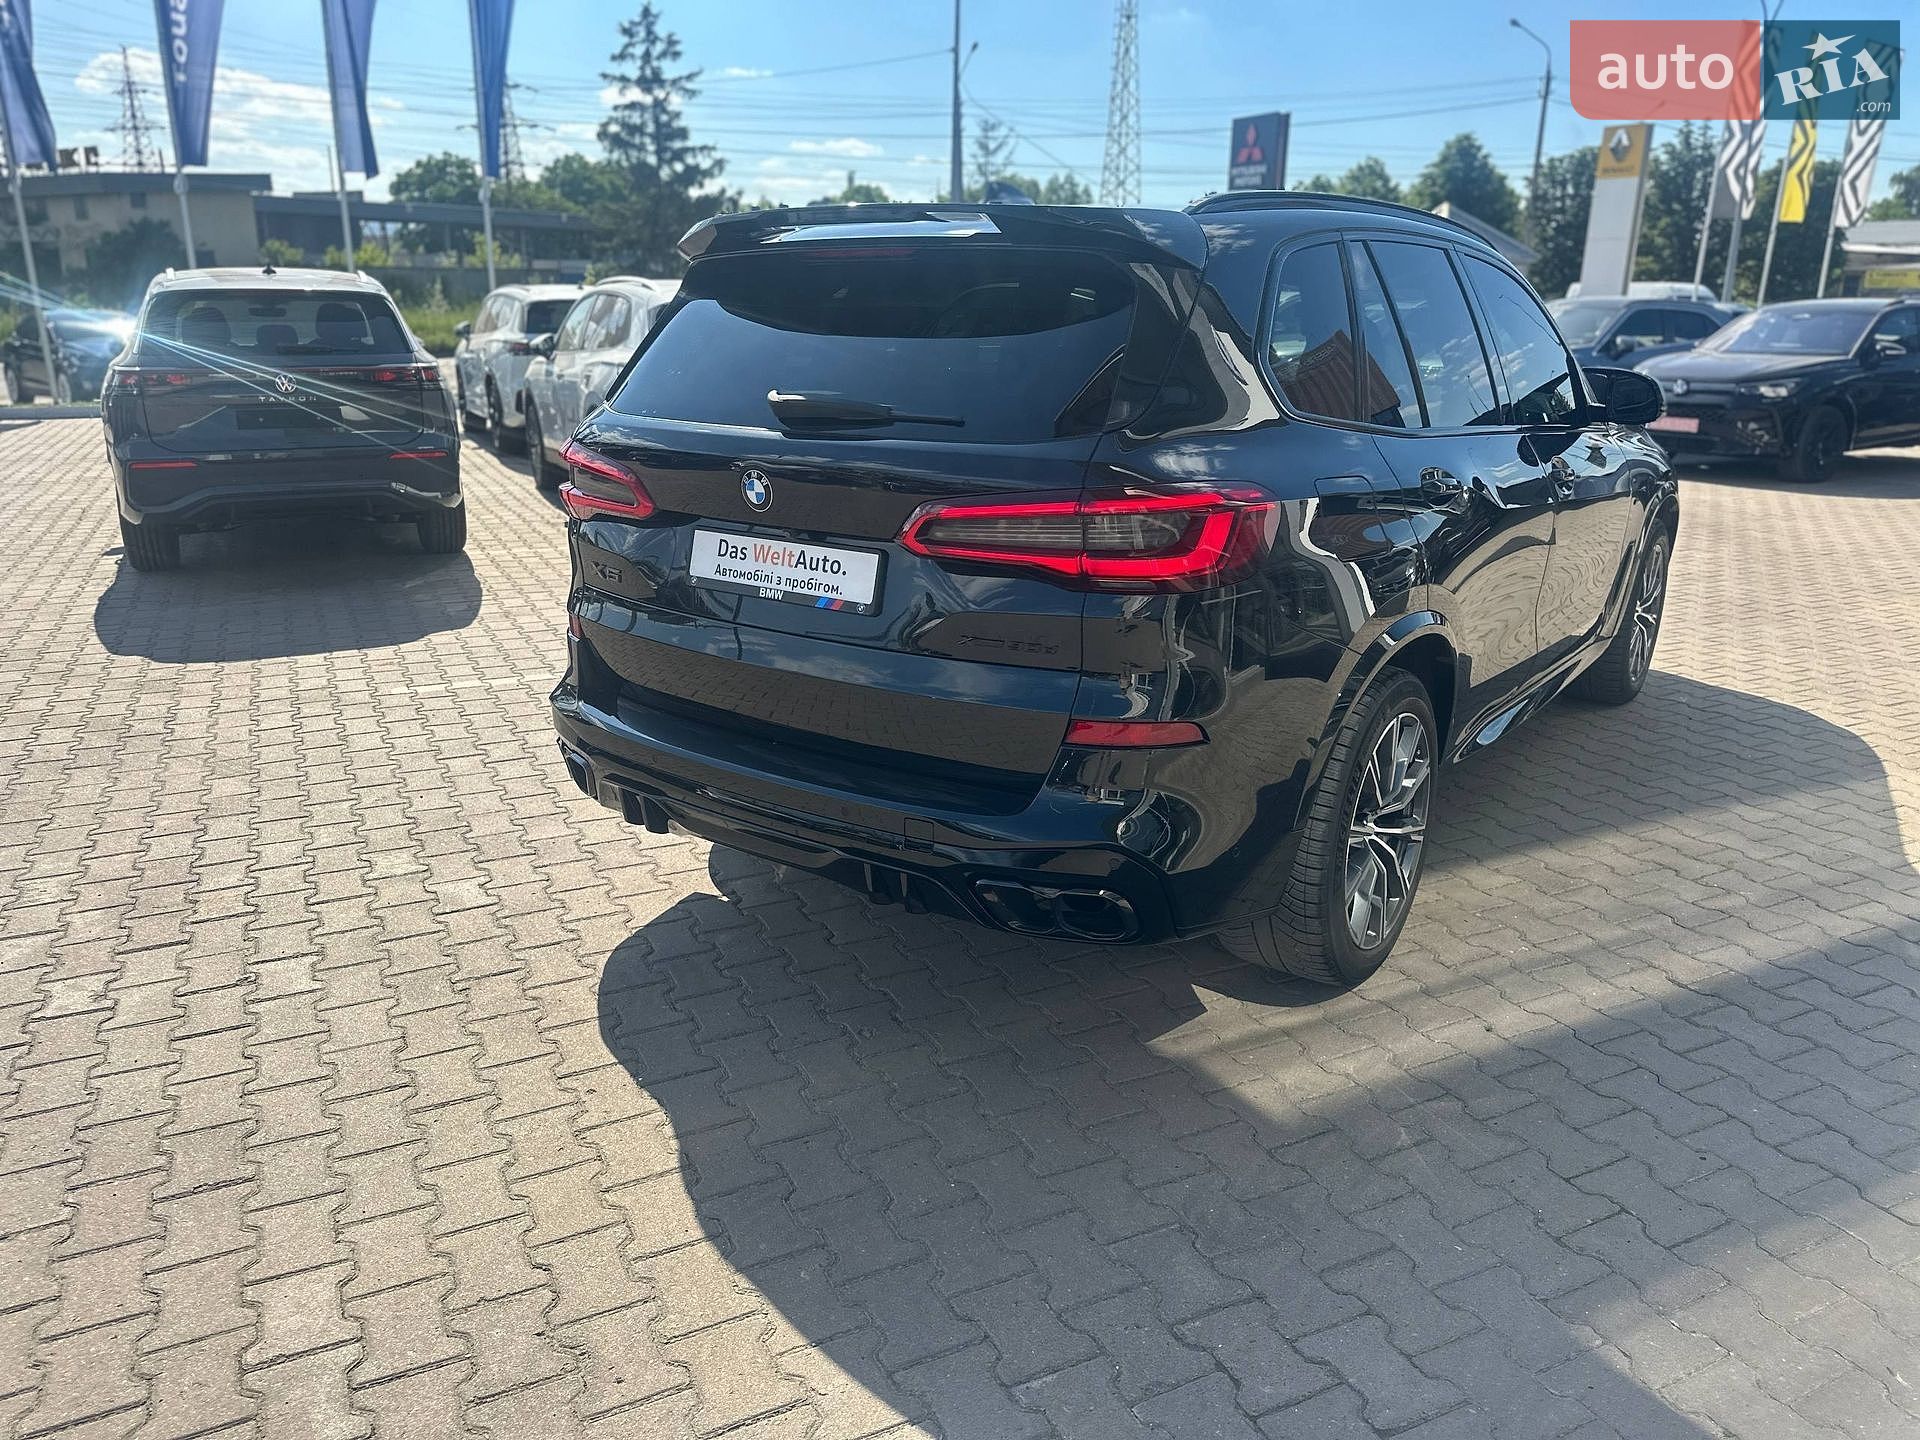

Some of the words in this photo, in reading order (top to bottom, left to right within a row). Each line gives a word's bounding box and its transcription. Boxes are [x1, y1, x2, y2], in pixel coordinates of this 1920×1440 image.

[717, 538, 748, 561] Das
[752, 543, 847, 576] WeltAuto.
[714, 563, 774, 585] Автомобілі
[775, 575, 782, 586] з
[784, 575, 843, 596] пробігом.
[759, 587, 784, 600] BMW
